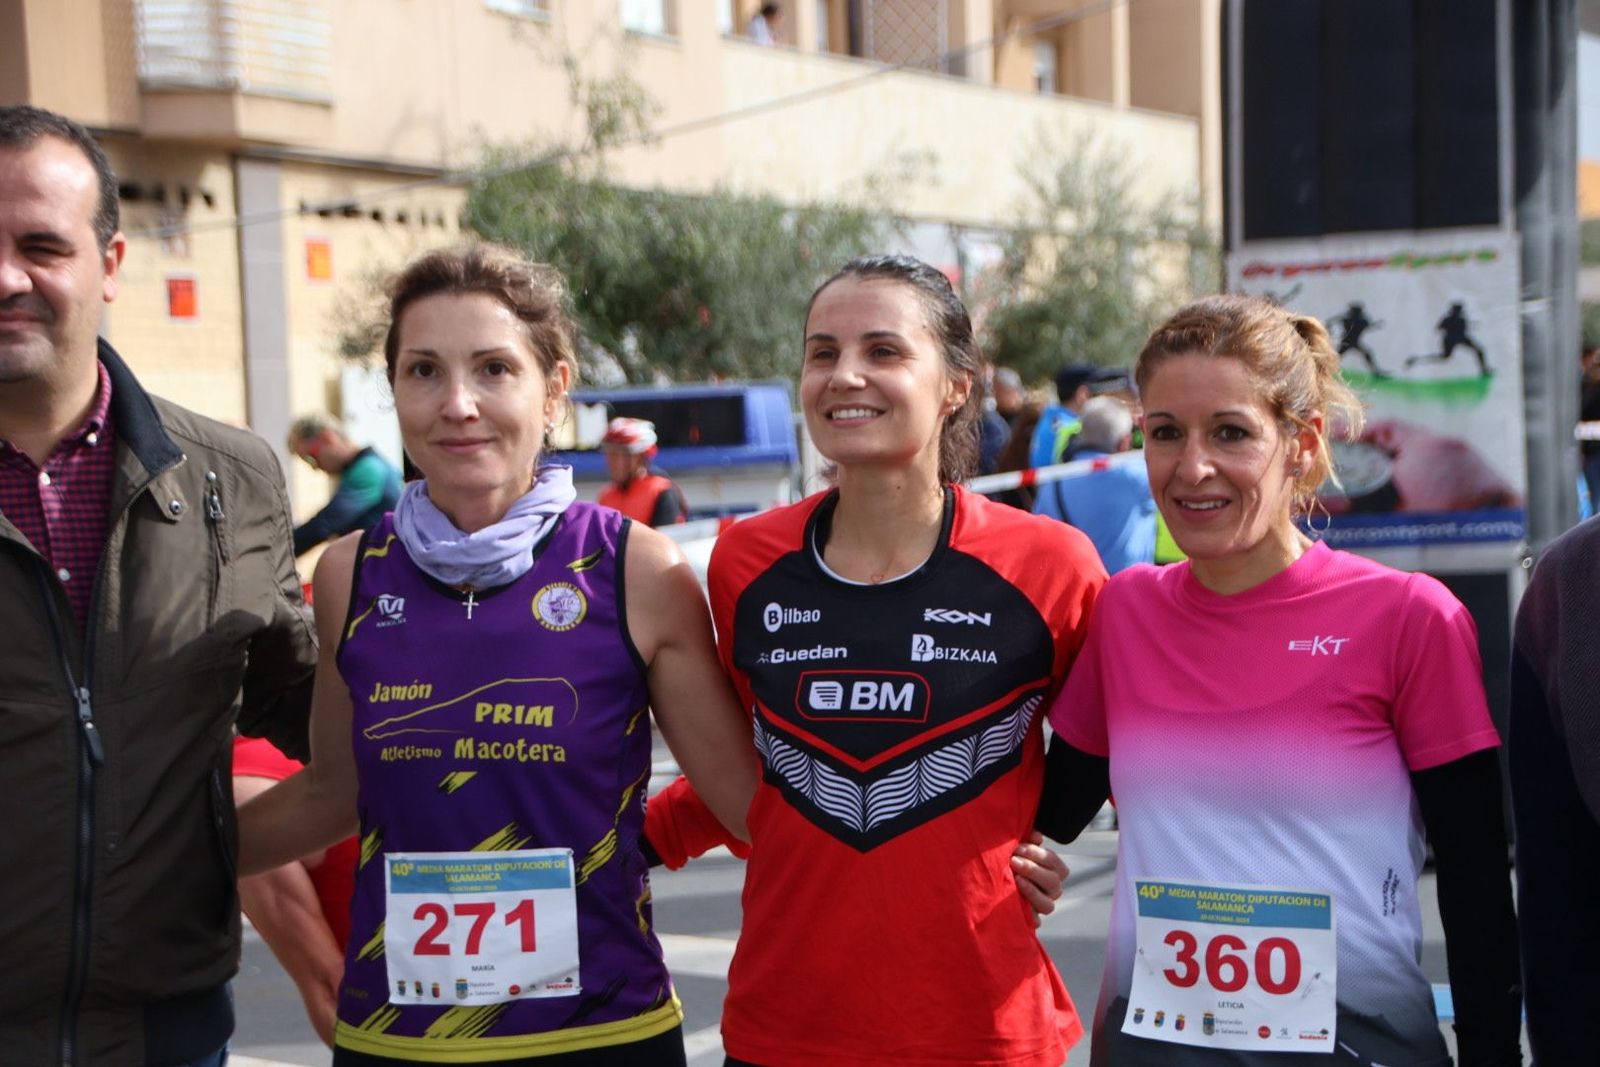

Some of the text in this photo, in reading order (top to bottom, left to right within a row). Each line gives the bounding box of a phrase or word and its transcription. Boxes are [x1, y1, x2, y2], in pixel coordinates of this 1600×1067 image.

[764, 602, 821, 632] Bilbao
[924, 608, 991, 626] KON
[770, 645, 848, 664] Guedan
[1288, 635, 1350, 656] EKT
[935, 647, 998, 664] BIZKAIA
[369, 679, 433, 703] Jamón
[850, 681, 915, 711] BM
[475, 702, 554, 727] PRIM
[381, 746, 442, 761] Atletismo
[454, 737, 566, 763] Macotera
[417, 865, 443, 874] MEDIA
[554, 860, 567, 869] DE
[445, 873, 501, 882] SALAMANCA
[1168, 888, 1197, 899] MEDIA
[1198, 891, 1245, 902] MARATON
[1248, 894, 1311, 906] DIPUTACION
[1314, 898, 1327, 907] DE
[1196, 901, 1255, 913] SALAMANCA
[413, 899, 537, 956] 271
[1163, 929, 1302, 995] 360
[1218, 1001, 1245, 1009] LETICIA
